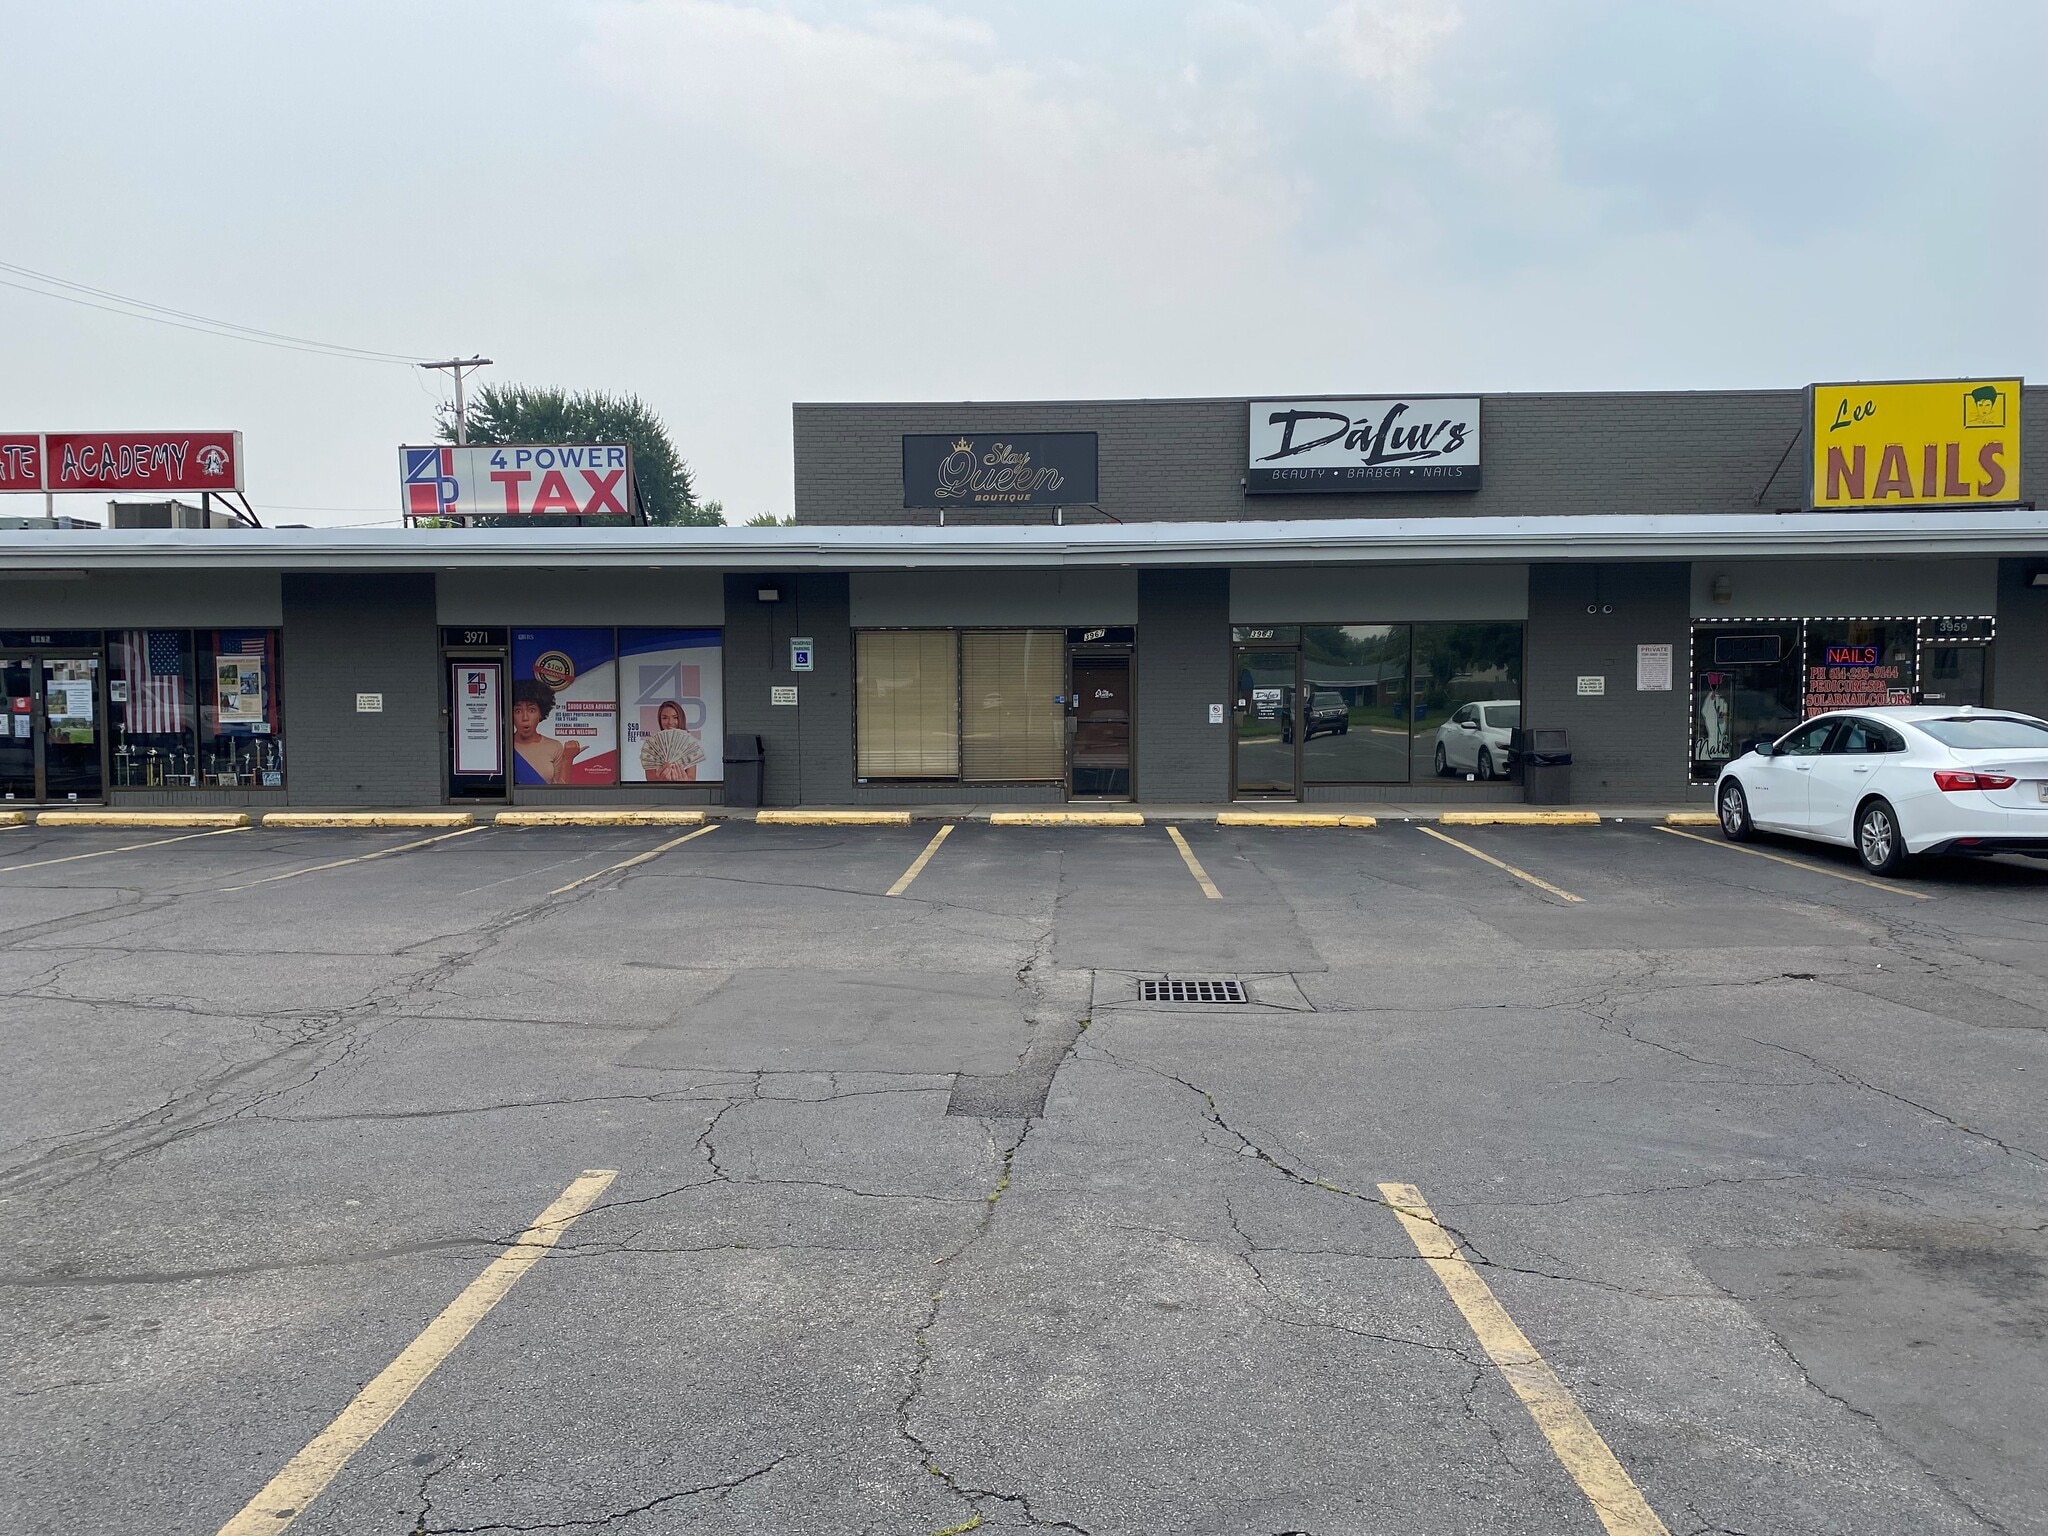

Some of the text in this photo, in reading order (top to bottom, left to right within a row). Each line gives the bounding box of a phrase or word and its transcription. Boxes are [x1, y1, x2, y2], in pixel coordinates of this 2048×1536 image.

[1830, 399, 1877, 432] Lee
[61, 441, 189, 481] ACADEMY
[490, 447, 624, 469] 4 POWER
[983, 443, 1030, 474] Slay
[935, 450, 1065, 498] Queen
[1272, 466, 1463, 480] BEAUTY BARBER NAILS
[1826, 442, 2006, 500] NAILS
[490, 470, 628, 514] TAX
[975, 494, 1032, 502] BOUTIQUE
[1084, 629, 1105, 641] 3967
[1940, 622, 1968, 632] 3959
[464, 631, 488, 644] 3971
[1716, 638, 1778, 661] OPEN
[1828, 648, 1875, 663] NAILS
[546, 662, 563, 672] $100
[1810, 667, 1826, 679] PH
[627, 722, 639, 731] $50
[1695, 738, 1729, 759] Nails
